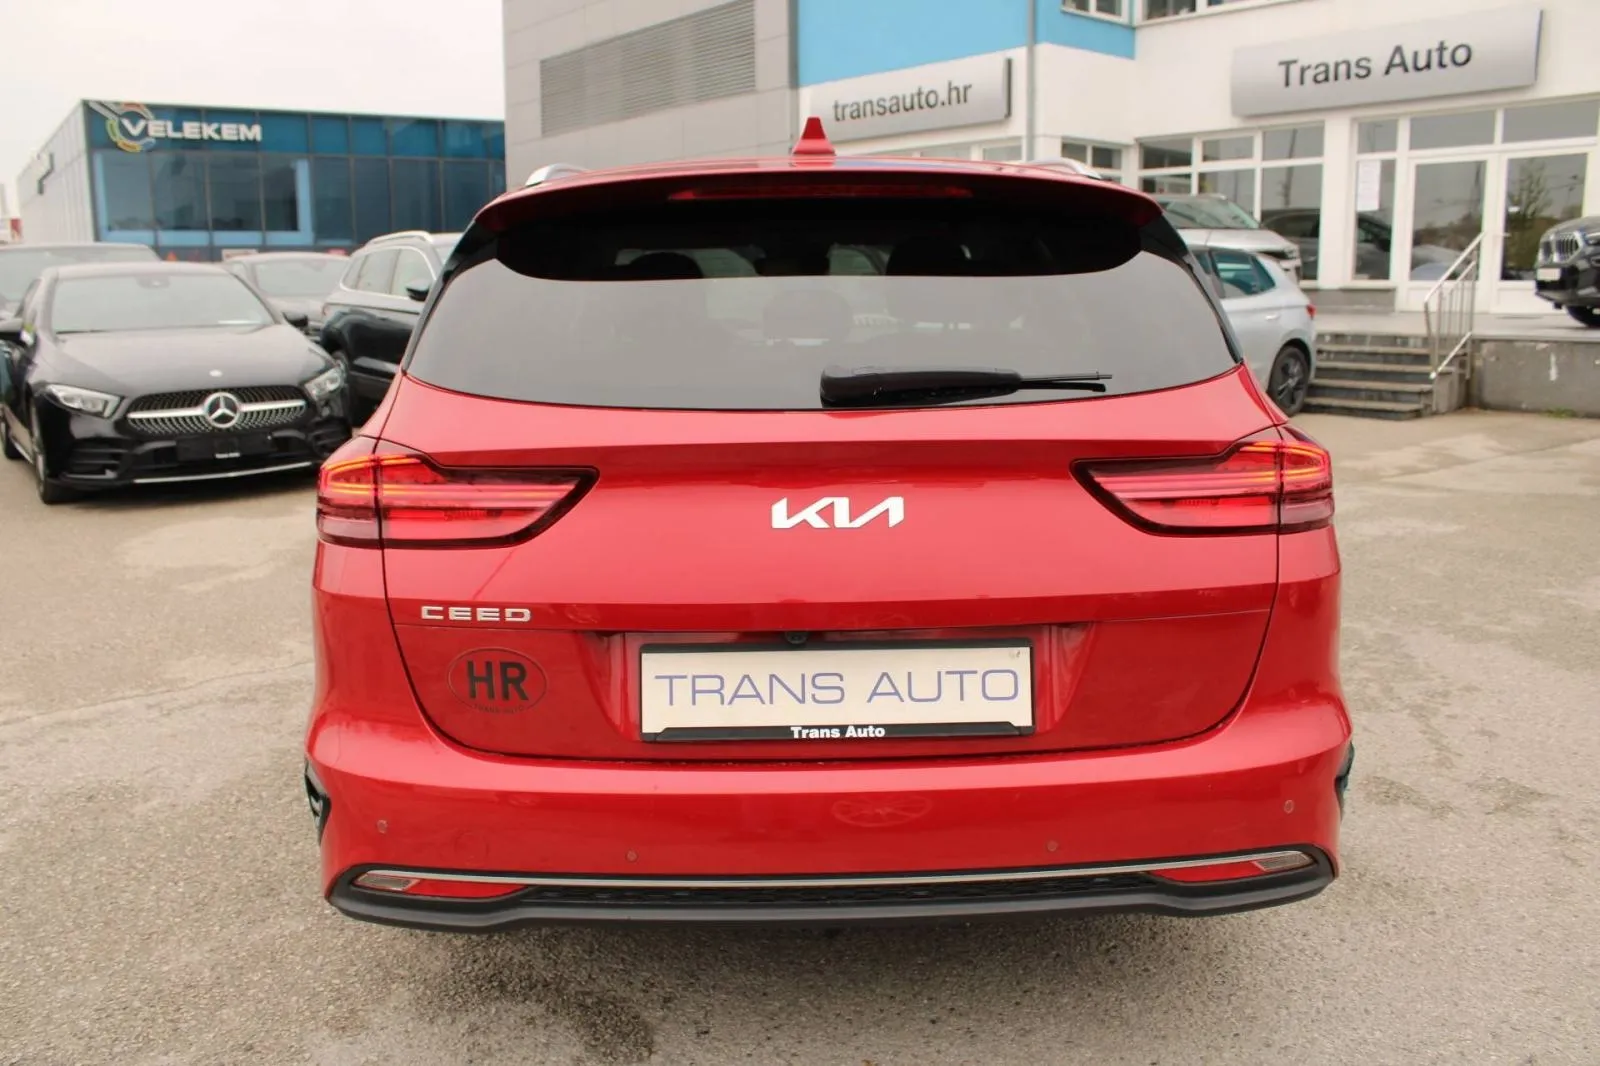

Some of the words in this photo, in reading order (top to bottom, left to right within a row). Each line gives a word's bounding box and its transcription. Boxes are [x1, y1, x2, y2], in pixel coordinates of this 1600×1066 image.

[1278, 59, 1372, 88] Trans
[1384, 40, 1473, 76] Auto
[833, 80, 972, 121] transauto.hr
[121, 118, 263, 142] VELEKEM
[771, 497, 904, 529] KIA
[421, 606, 531, 622] CEED
[467, 660, 529, 701] HR
[655, 673, 845, 706] TRANS
[866, 669, 1020, 703] AUTO
[790, 726, 840, 738] Trans
[845, 725, 885, 737] Auto
